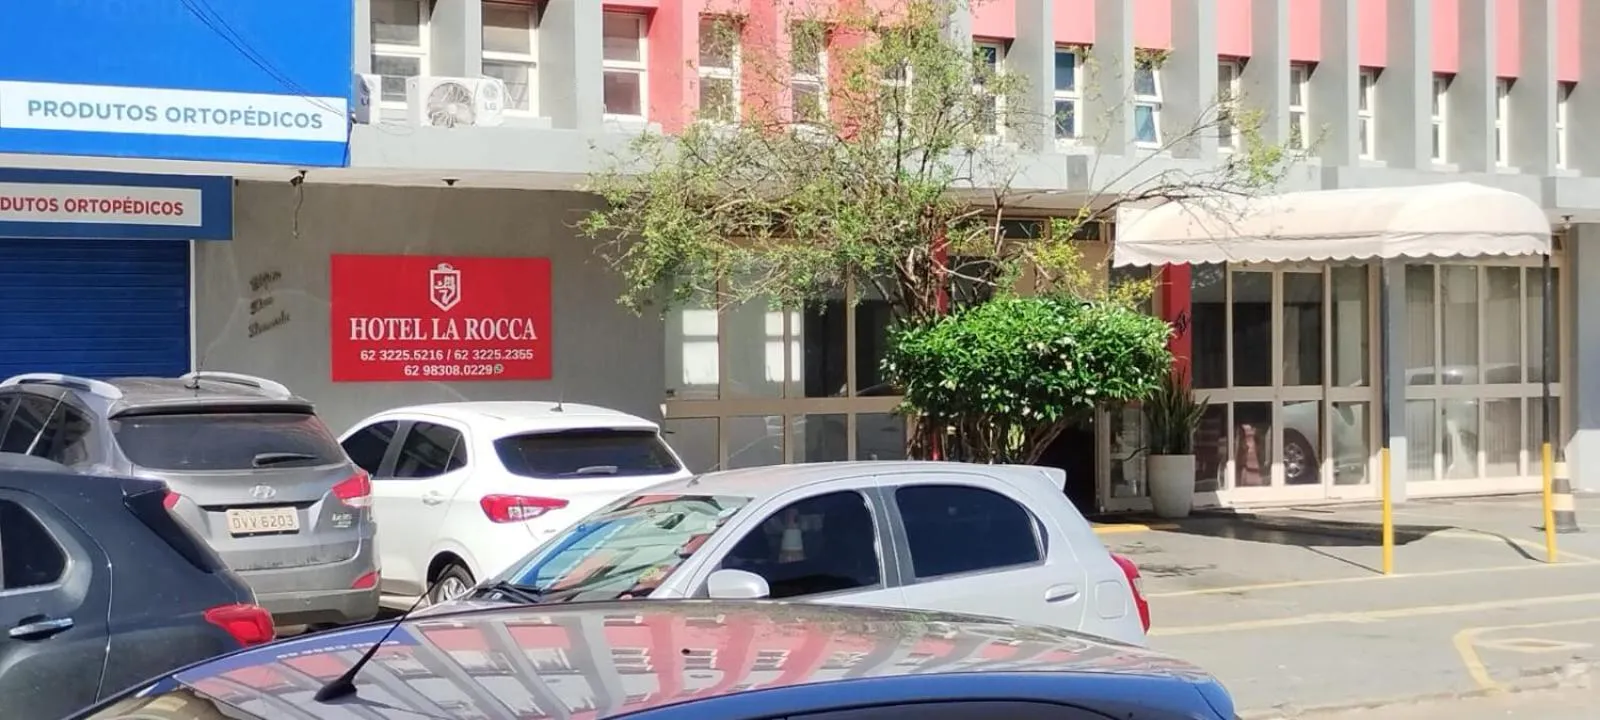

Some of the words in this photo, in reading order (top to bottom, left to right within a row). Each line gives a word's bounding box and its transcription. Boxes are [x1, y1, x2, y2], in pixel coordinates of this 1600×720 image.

[484, 101, 497, 111] LG
[28, 99, 158, 122] PRODUTOS
[165, 105, 323, 130] ORTOPÉDICOS
[64, 197, 184, 216] ORTOPÉDICOS
[349, 316, 427, 341] HOTEL
[431, 317, 460, 341] LA
[464, 317, 538, 341] ROCCA
[360, 349, 376, 361] 62
[379, 349, 444, 361] 3225.5216
[453, 349, 469, 361] 62
[473, 348, 534, 361] 3225.2355
[404, 364, 420, 377] 62
[422, 363, 493, 377] 98308.0229
